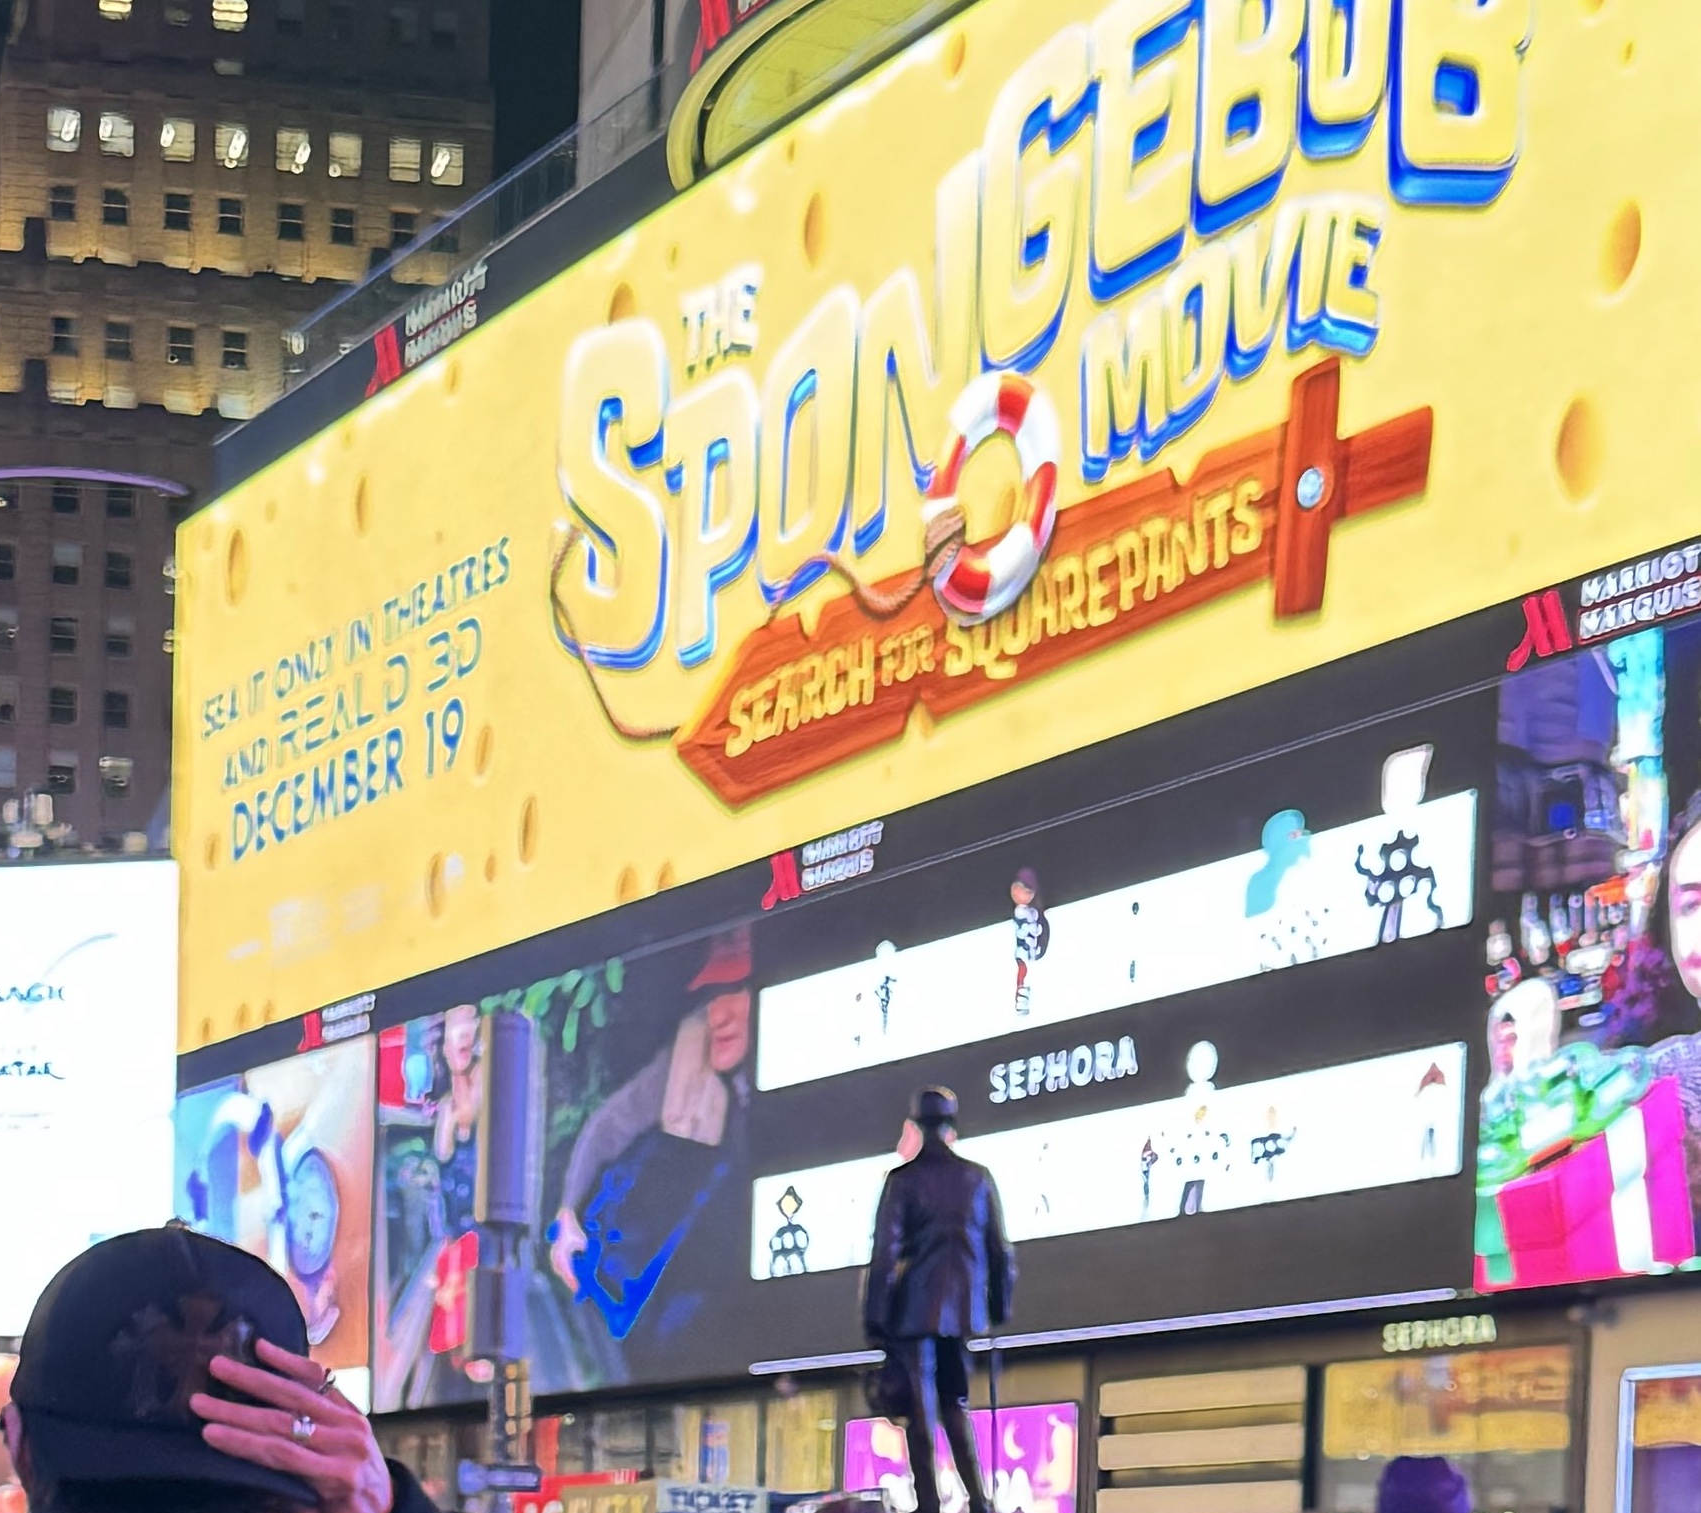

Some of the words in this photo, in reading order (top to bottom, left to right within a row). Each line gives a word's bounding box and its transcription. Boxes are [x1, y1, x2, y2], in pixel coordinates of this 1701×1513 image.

[679, 262, 764, 377] THE
[1080, 195, 1390, 485] MOVIE
[274, 633, 336, 699] ONLY
[348, 611, 375, 664] IN
[382, 536, 510, 646] THEATRES
[724, 632, 875, 758] SEARCH
[880, 623, 936, 687] FOR
[944, 476, 1268, 679] SQUAREPANTS
[232, 727, 404, 862] DECEMBER
[425, 697, 465, 779] 19
[989, 1035, 1139, 1104] SEPHORA
[1382, 1314, 1497, 1353] SEPHORA
